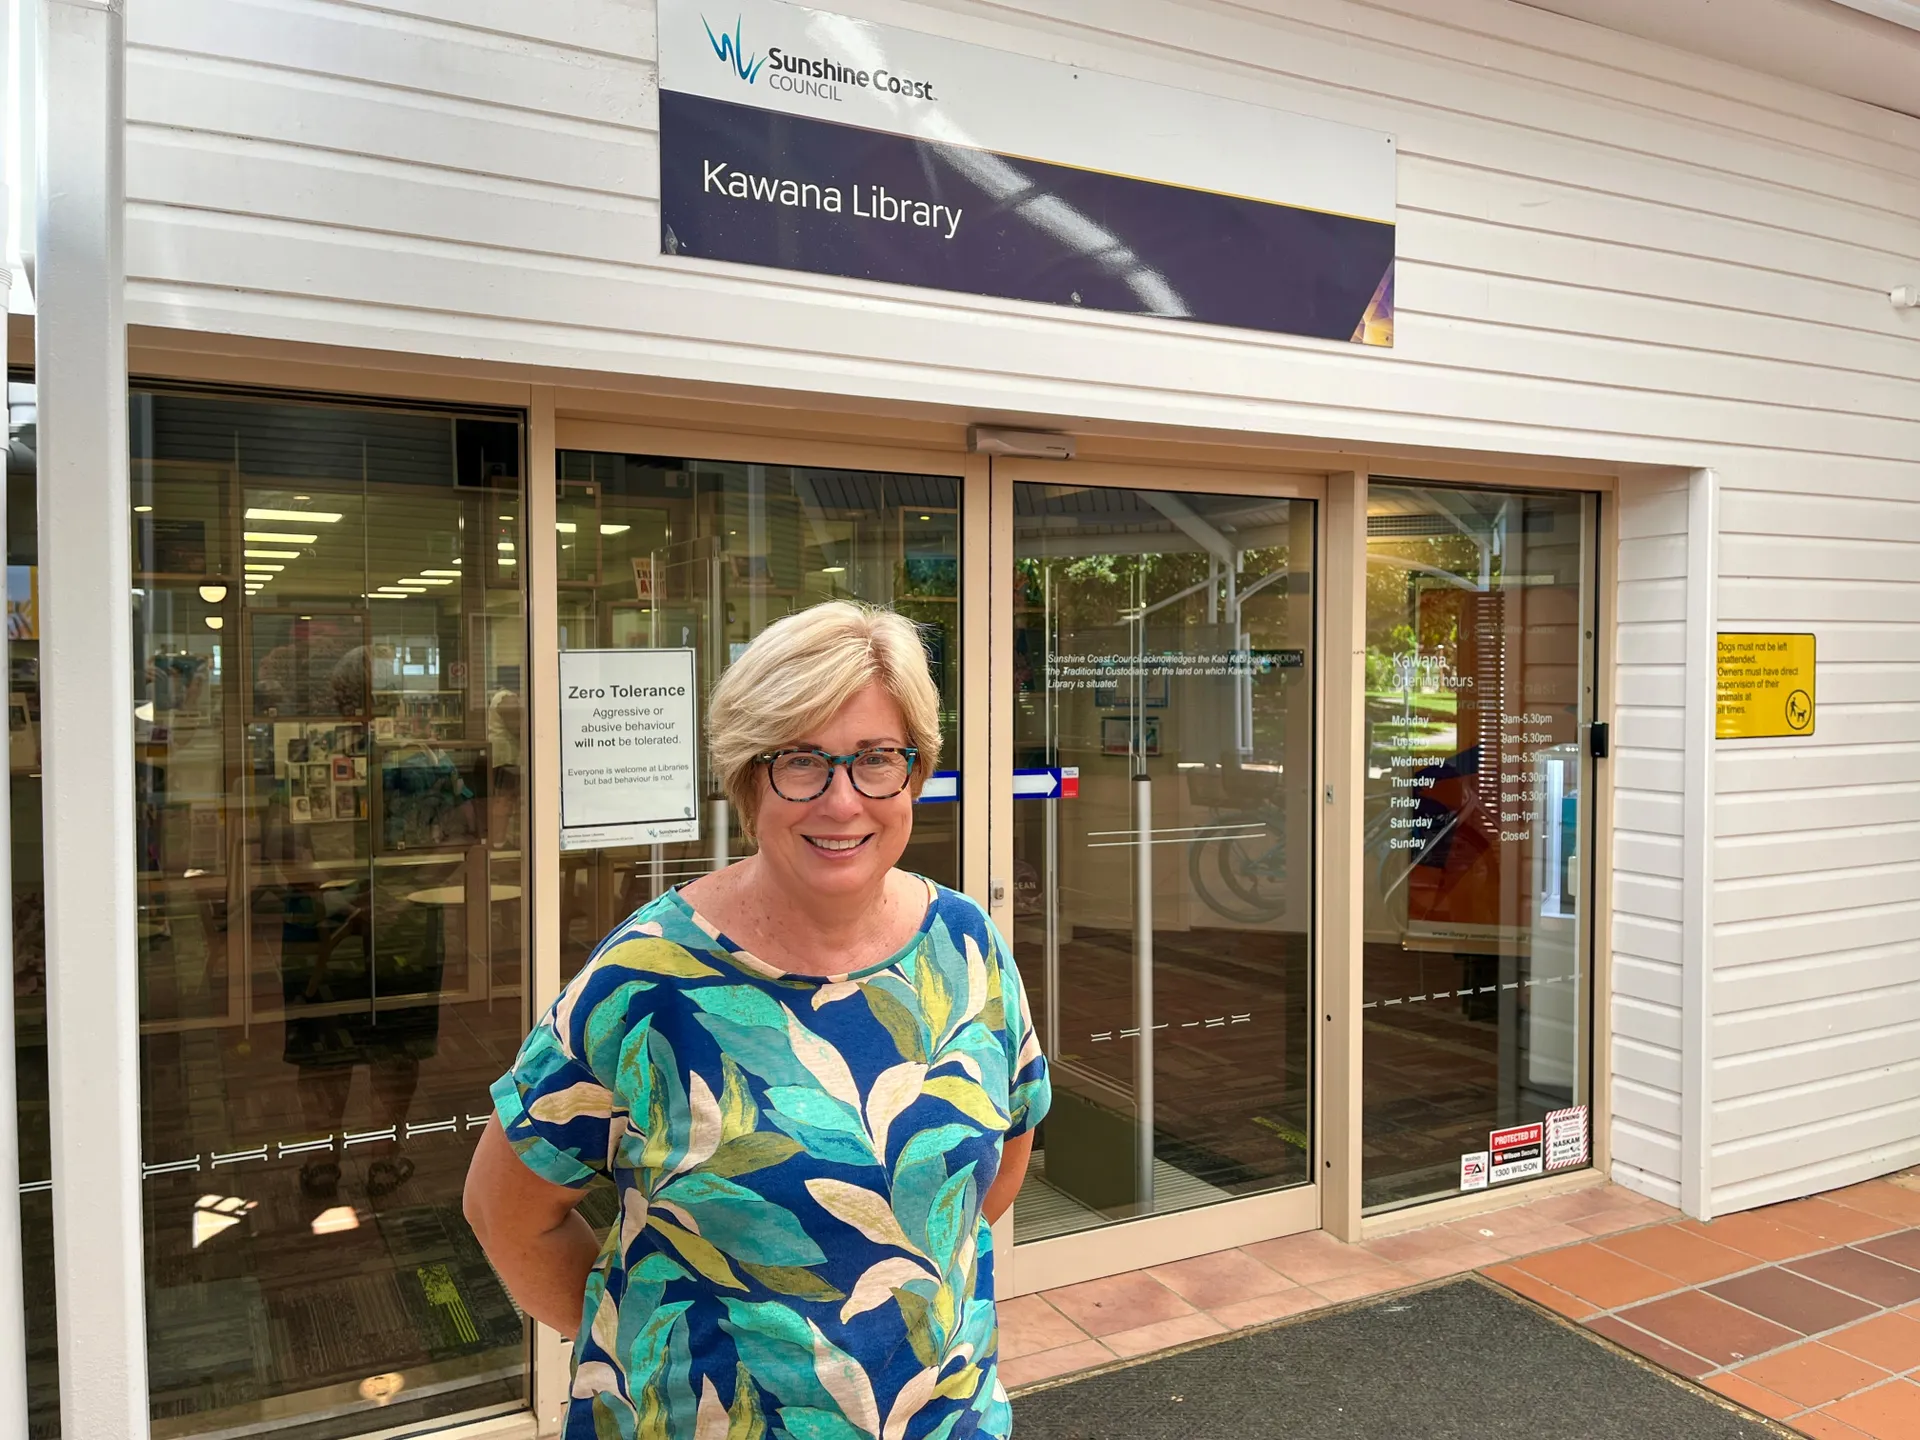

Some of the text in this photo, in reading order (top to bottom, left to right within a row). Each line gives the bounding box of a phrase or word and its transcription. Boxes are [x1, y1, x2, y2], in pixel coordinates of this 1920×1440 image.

[767, 47, 936, 102] Sunshine Coast
[768, 73, 843, 102] COUNCIL
[702, 159, 962, 239] Kawana Library
[1717, 642, 1788, 653] Dogs must not be left
[1047, 653, 1085, 664] Sunshine
[1086, 653, 1111, 664] Coast
[1112, 653, 1142, 664] Council
[1143, 654, 1196, 665] acknowledges
[1198, 654, 1210, 664] the
[1211, 654, 1228, 664] Kabi
[1392, 652, 1448, 669] Kawana
[1047, 666, 1257, 677] the Traditional Custodians of the land on which Kawana
[1717, 667, 1799, 677] Owners must have direct
[1047, 678, 1119, 690] Library is situated.
[1391, 674, 1440, 689] Opening
[1442, 675, 1474, 688] hours
[1717, 680, 1780, 691] supervision of their
[568, 684, 686, 699] Zero Tolerance
[1717, 692, 1752, 702] animals at
[592, 706, 664, 719] Aggressive or
[1717, 705, 1725, 714] all
[581, 720, 675, 733] abusive behaviour
[1391, 713, 1553, 727] Monday 9am-5.30pm
[574, 735, 682, 748] will not be tolerated.
[1391, 732, 1553, 748] Tuesday 9am-5.30pm
[1391, 752, 1552, 768] Wednesday 9am-5.30pm
[567, 768, 604, 777] Everyone
[606, 767, 613, 775] is
[614, 766, 647, 775] welcome
[657, 763, 689, 772] Libraries
[584, 773, 674, 786] but bad behaviour is not.
[1391, 776, 1436, 788] Thursday
[1390, 797, 1421, 809] Friday
[1390, 811, 1539, 829] Saturday 9am-1pm
[1390, 830, 1530, 850] Sunday Closed
[1014, 881, 1037, 890] CEAN
[1553, 1113, 1580, 1124] WARNING
[1494, 1129, 1539, 1146] PROTECTED BY
[1553, 1137, 1580, 1148] NASKAM
[1503, 1151, 1521, 1160] Wilson
[1495, 1161, 1539, 1177] 1300 WILSON
